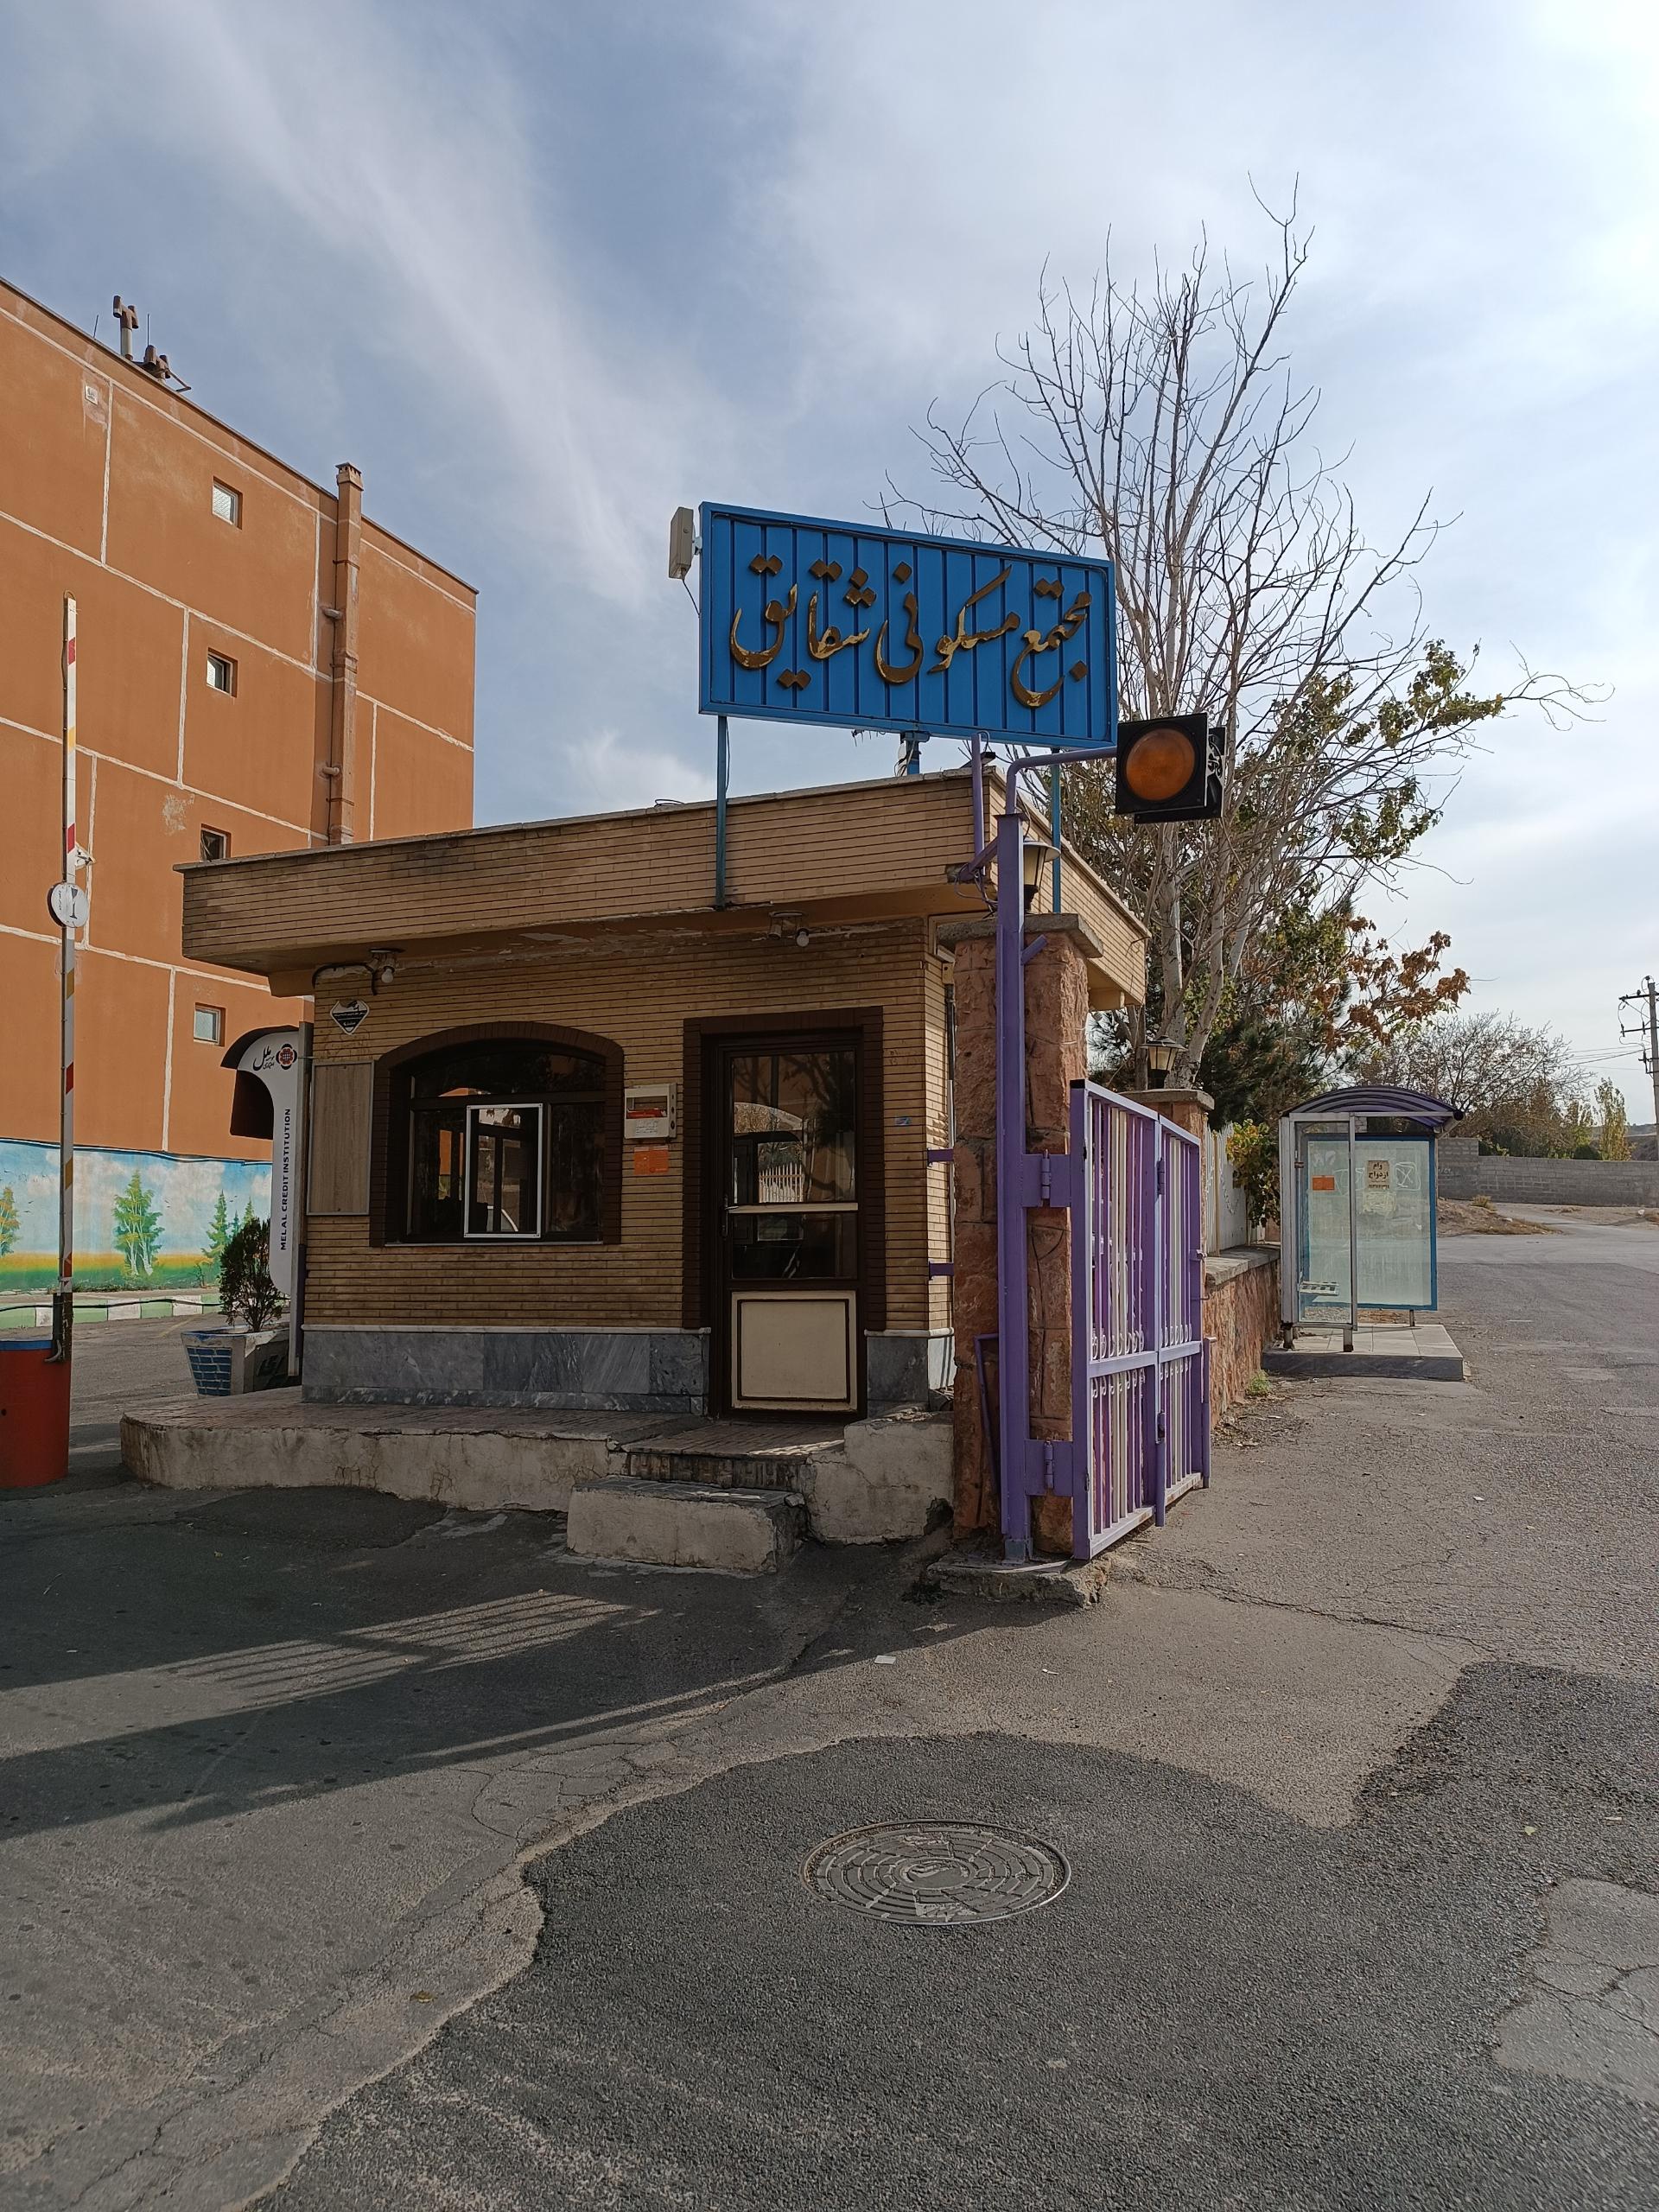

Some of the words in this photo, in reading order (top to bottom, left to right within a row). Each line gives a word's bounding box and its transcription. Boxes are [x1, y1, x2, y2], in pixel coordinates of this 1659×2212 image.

[729, 553, 877, 690] شقایق
[874, 561, 1021, 685] مسکونی
[1011, 577, 1092, 709] مجتمع
[283, 1109, 291, 1173] INSTITUTION
